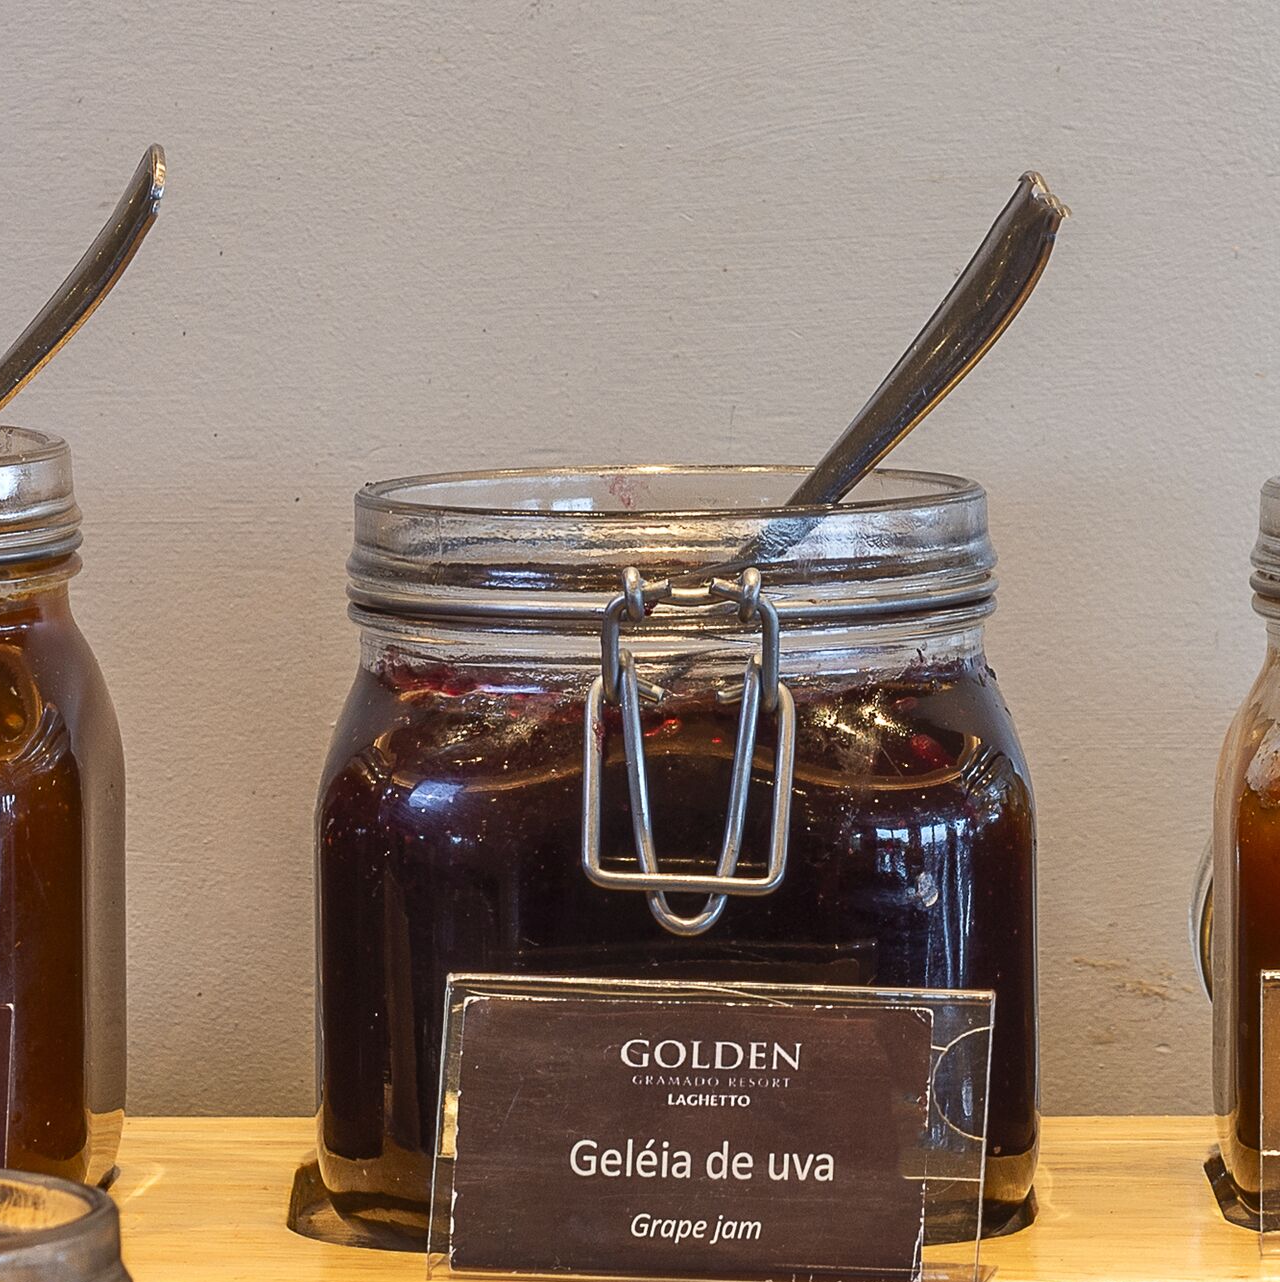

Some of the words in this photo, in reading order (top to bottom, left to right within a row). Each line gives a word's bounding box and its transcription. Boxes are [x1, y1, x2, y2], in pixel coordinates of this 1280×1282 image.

[620, 1039, 802, 1071] GOLDEN
[631, 1075, 720, 1087] GRAMADO
[728, 1077, 792, 1089] RESORT
[667, 1093, 751, 1108] LAGHETTO
[569, 1138, 692, 1179] Geléia
[706, 1140, 754, 1181] de
[768, 1152, 834, 1182] uva
[630, 1213, 708, 1244] Grape
[709, 1214, 762, 1245] jam
